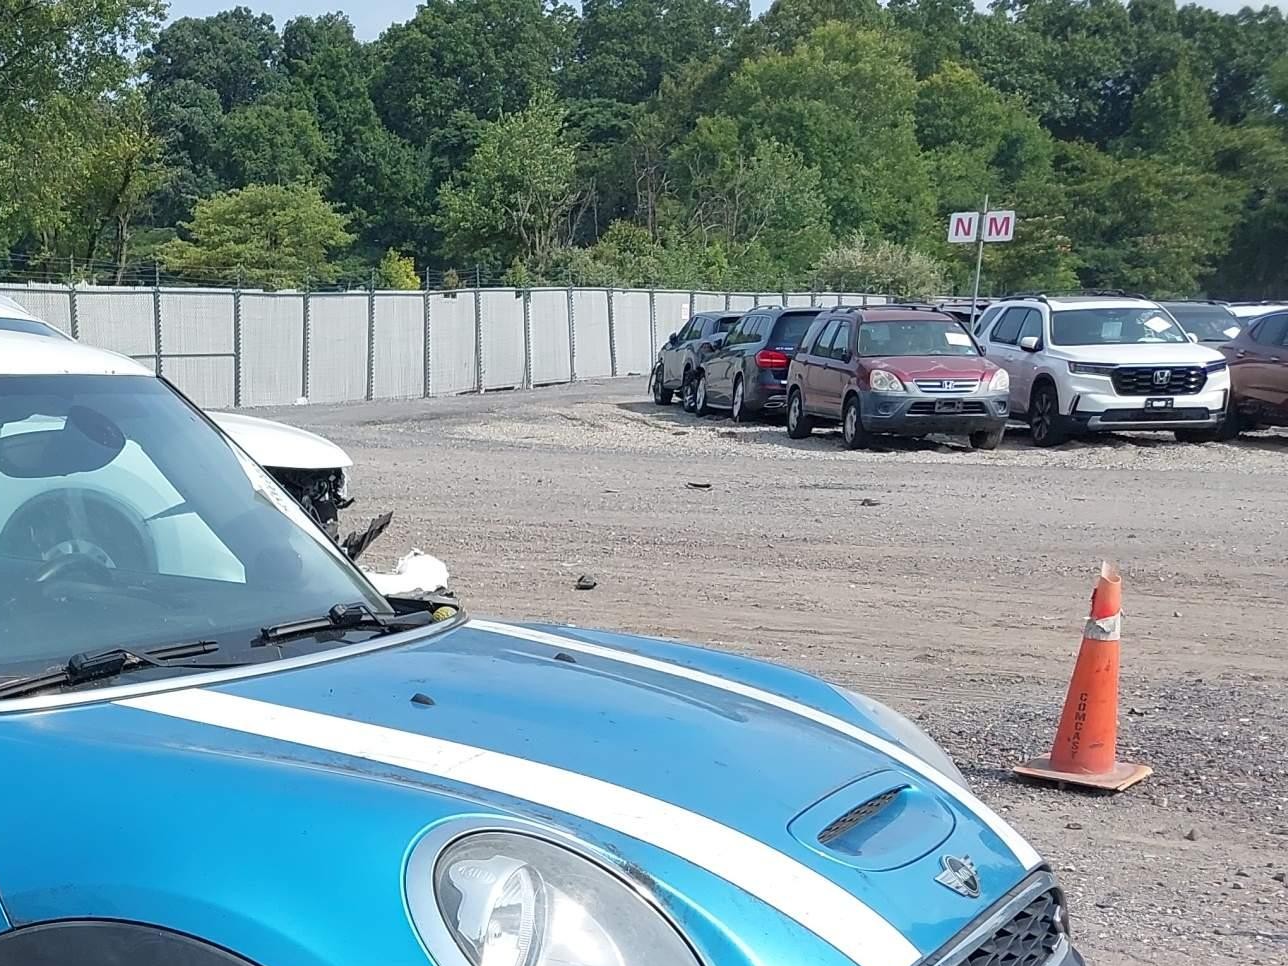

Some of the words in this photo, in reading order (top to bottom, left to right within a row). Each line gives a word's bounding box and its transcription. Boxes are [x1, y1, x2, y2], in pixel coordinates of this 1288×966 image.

[954, 216, 973, 237] N
[988, 216, 1010, 237] M
[1070, 692, 1088, 761] COMCAST
